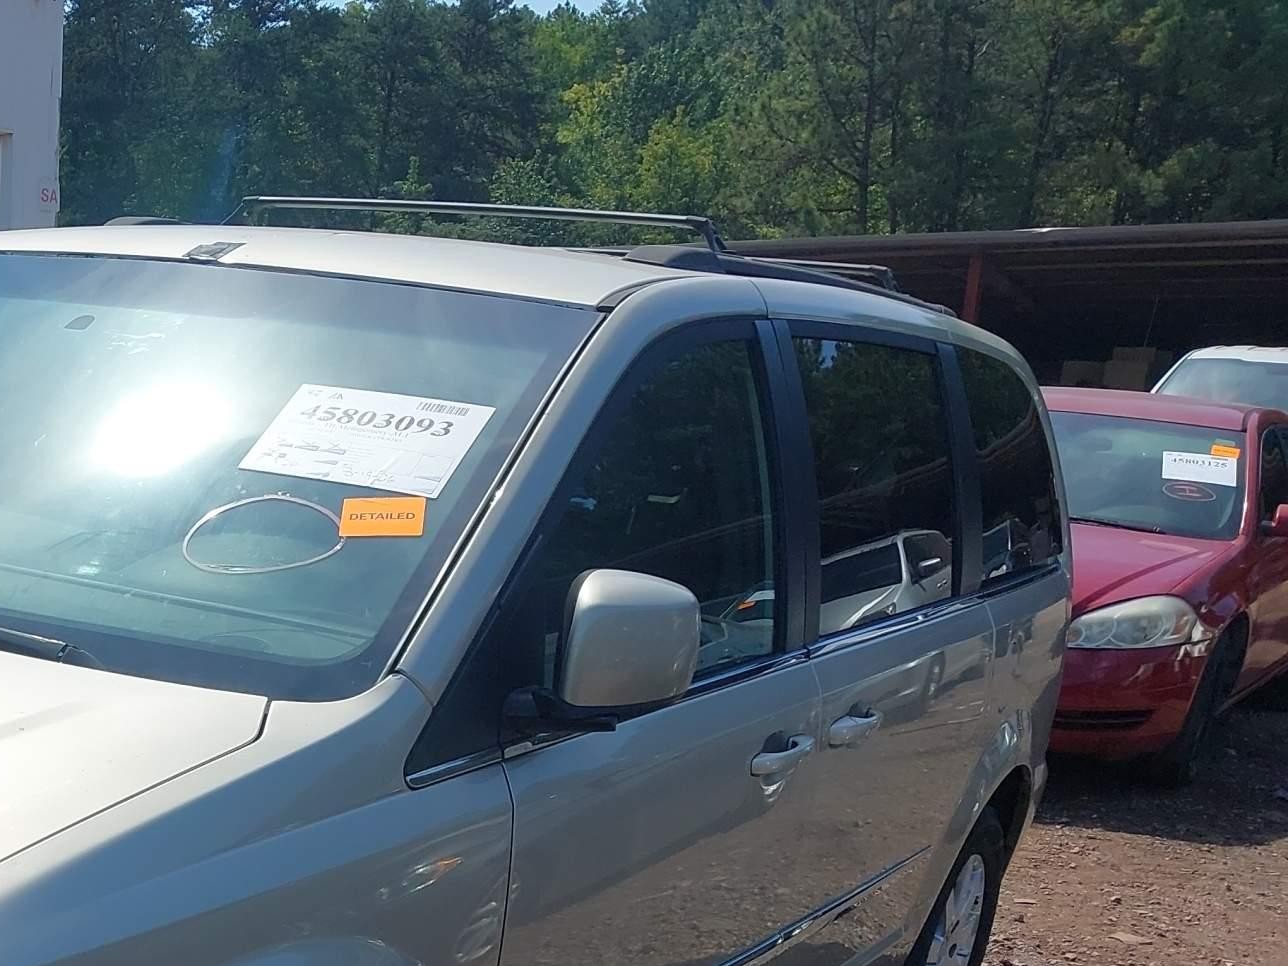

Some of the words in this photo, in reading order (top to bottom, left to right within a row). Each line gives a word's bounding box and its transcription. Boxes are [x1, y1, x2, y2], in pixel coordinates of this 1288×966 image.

[40, 187, 58, 204] SA
[300, 404, 455, 437] 45803093
[349, 512, 416, 521] DETAILED
